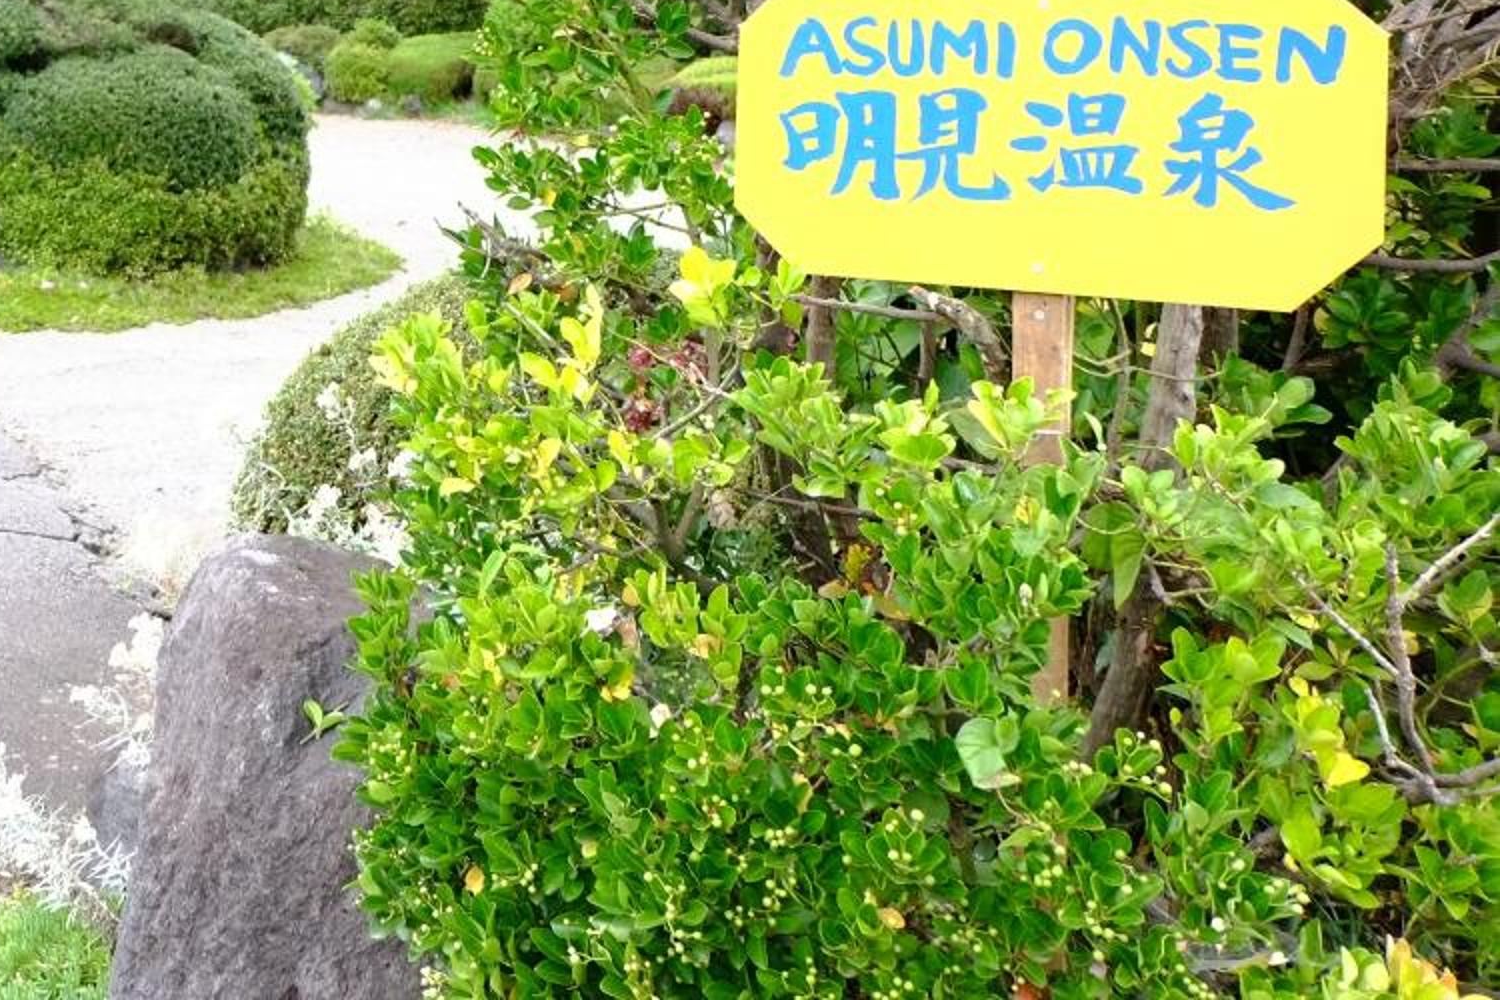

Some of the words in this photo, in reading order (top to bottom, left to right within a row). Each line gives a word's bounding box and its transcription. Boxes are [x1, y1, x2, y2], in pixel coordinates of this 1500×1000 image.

[779, 17, 1016, 79] ASUMI
[1043, 17, 1347, 85] ONSEN
[779, 87, 1298, 211] 明見温泉
